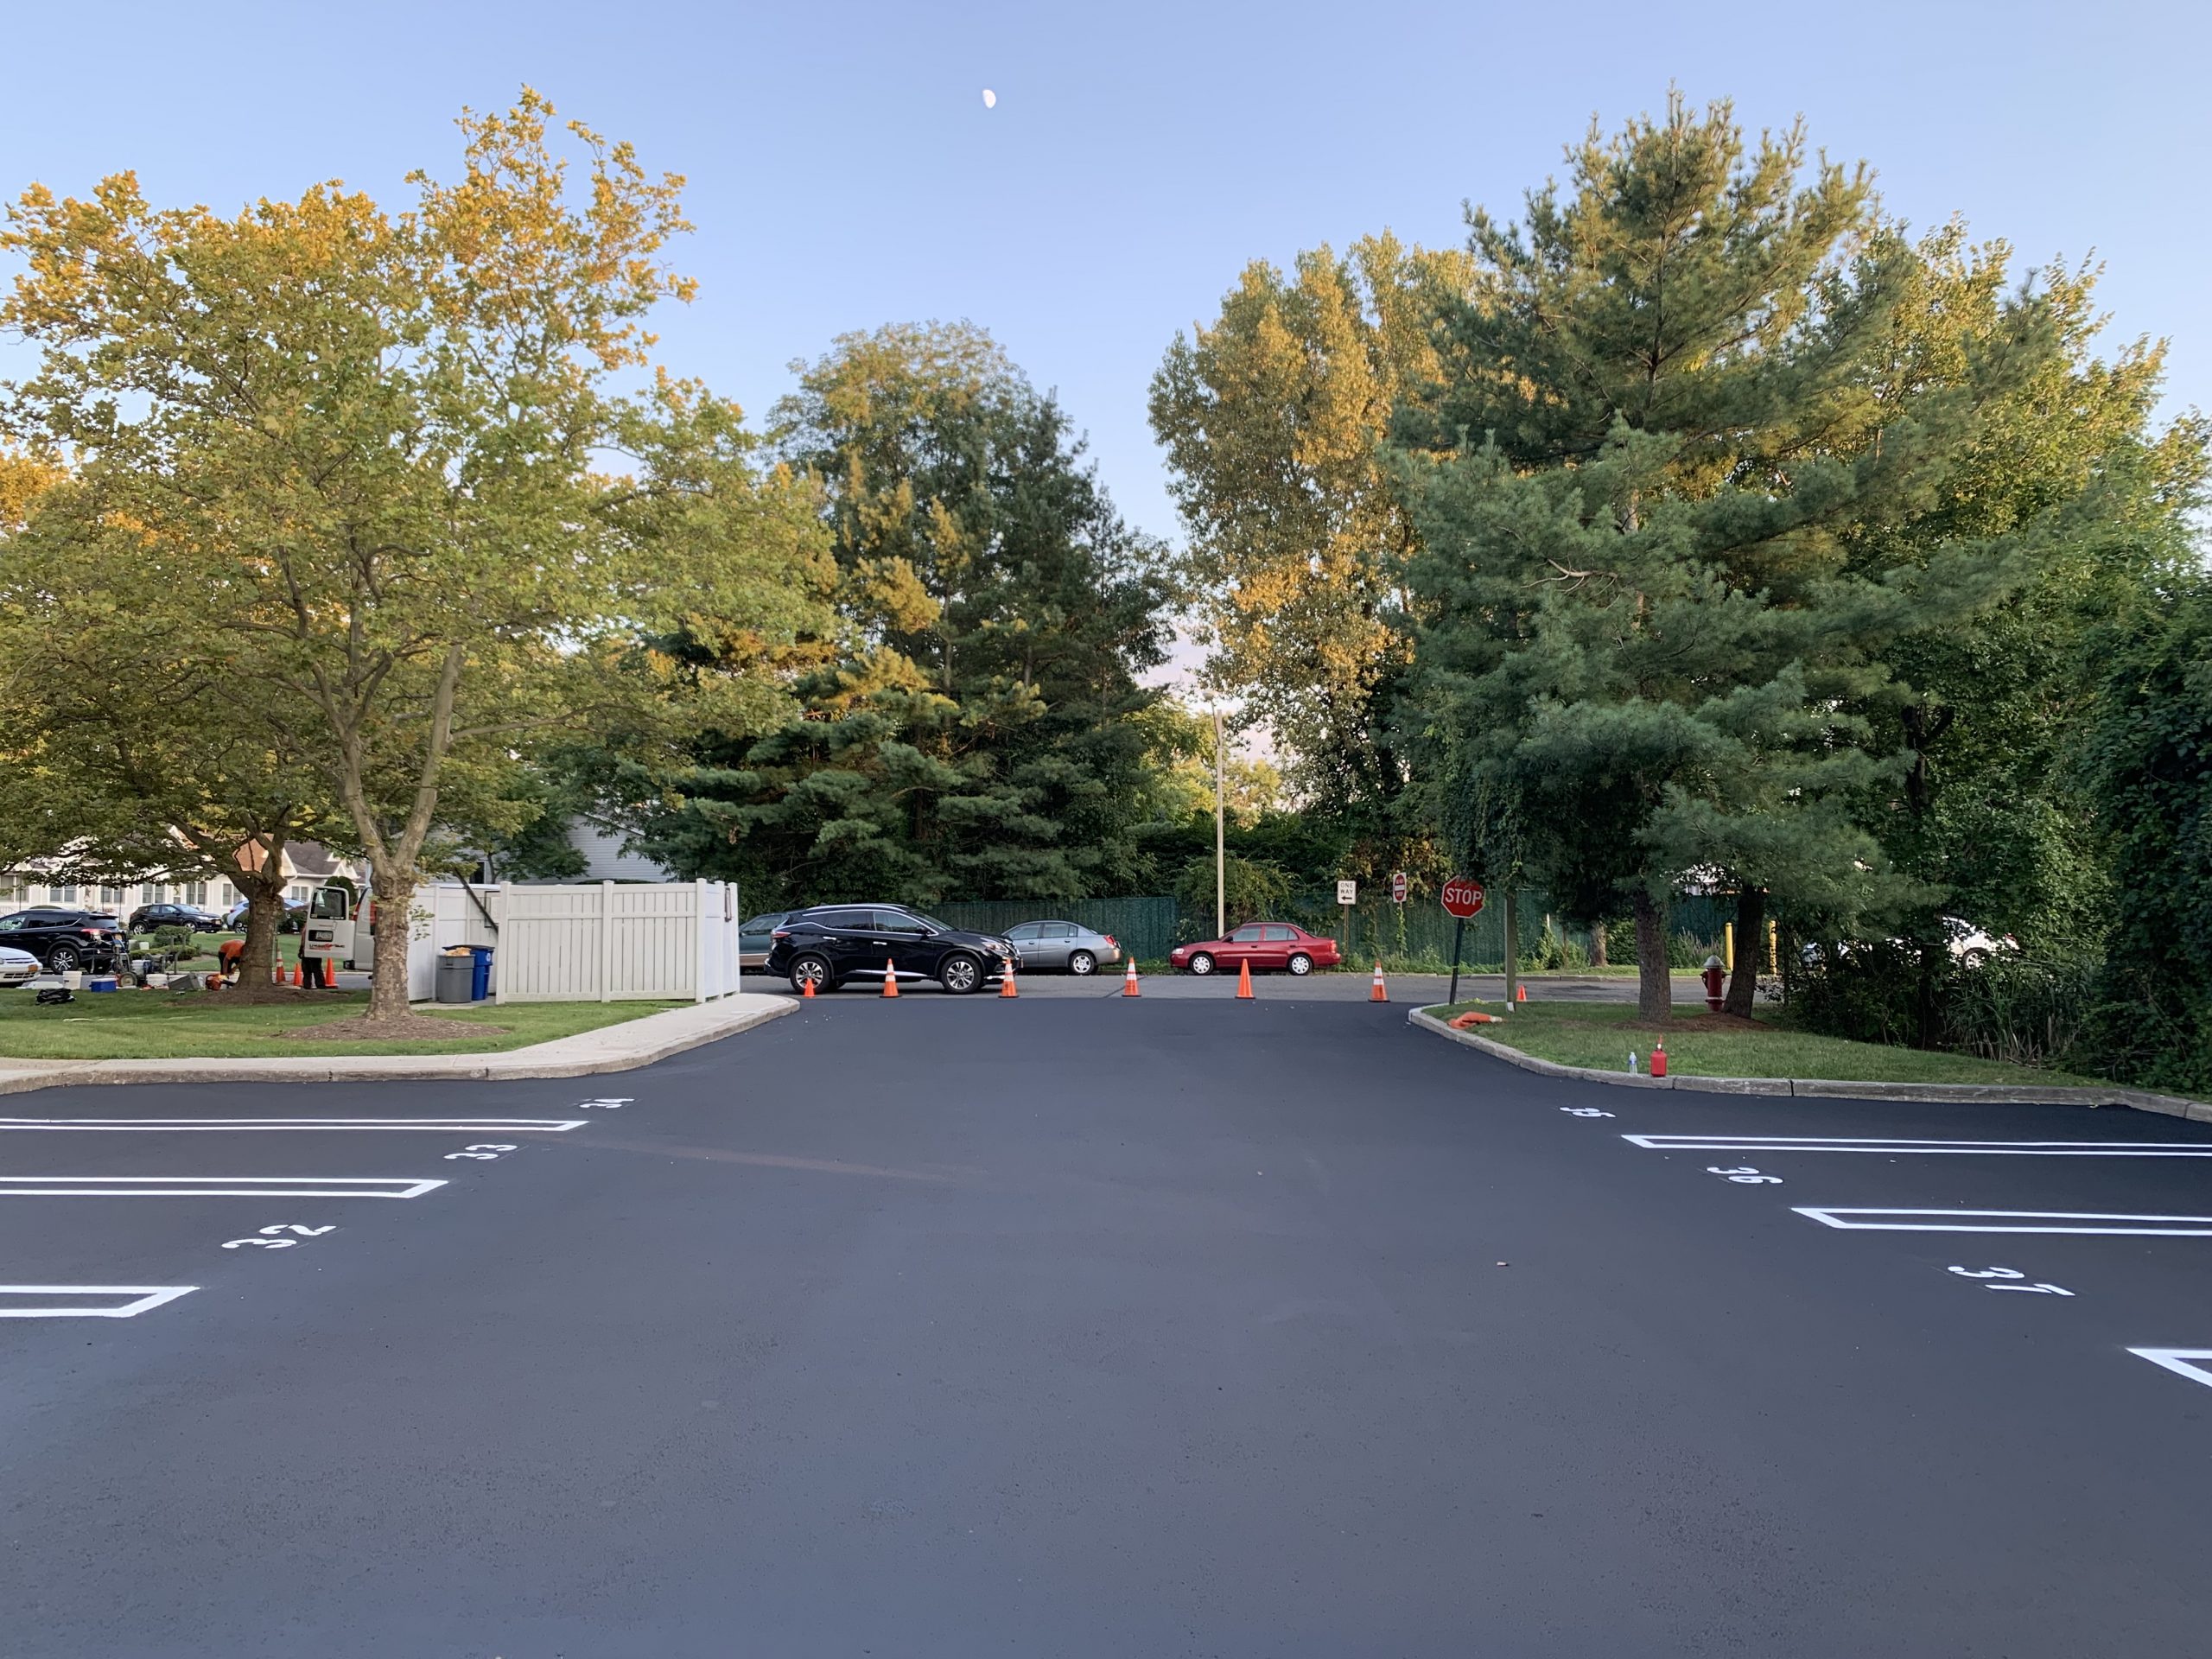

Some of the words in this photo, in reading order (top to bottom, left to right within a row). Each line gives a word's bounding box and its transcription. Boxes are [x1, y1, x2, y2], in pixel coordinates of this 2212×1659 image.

[1445, 887, 1482, 906] STOP
[579, 1098, 635, 1109] 34
[1560, 1107, 1616, 1118] 35
[443, 1144, 518, 1160] 33
[1707, 1166, 1783, 1184] 36
[220, 1224, 337, 1249] 32
[1948, 1266, 2075, 1296] 37
